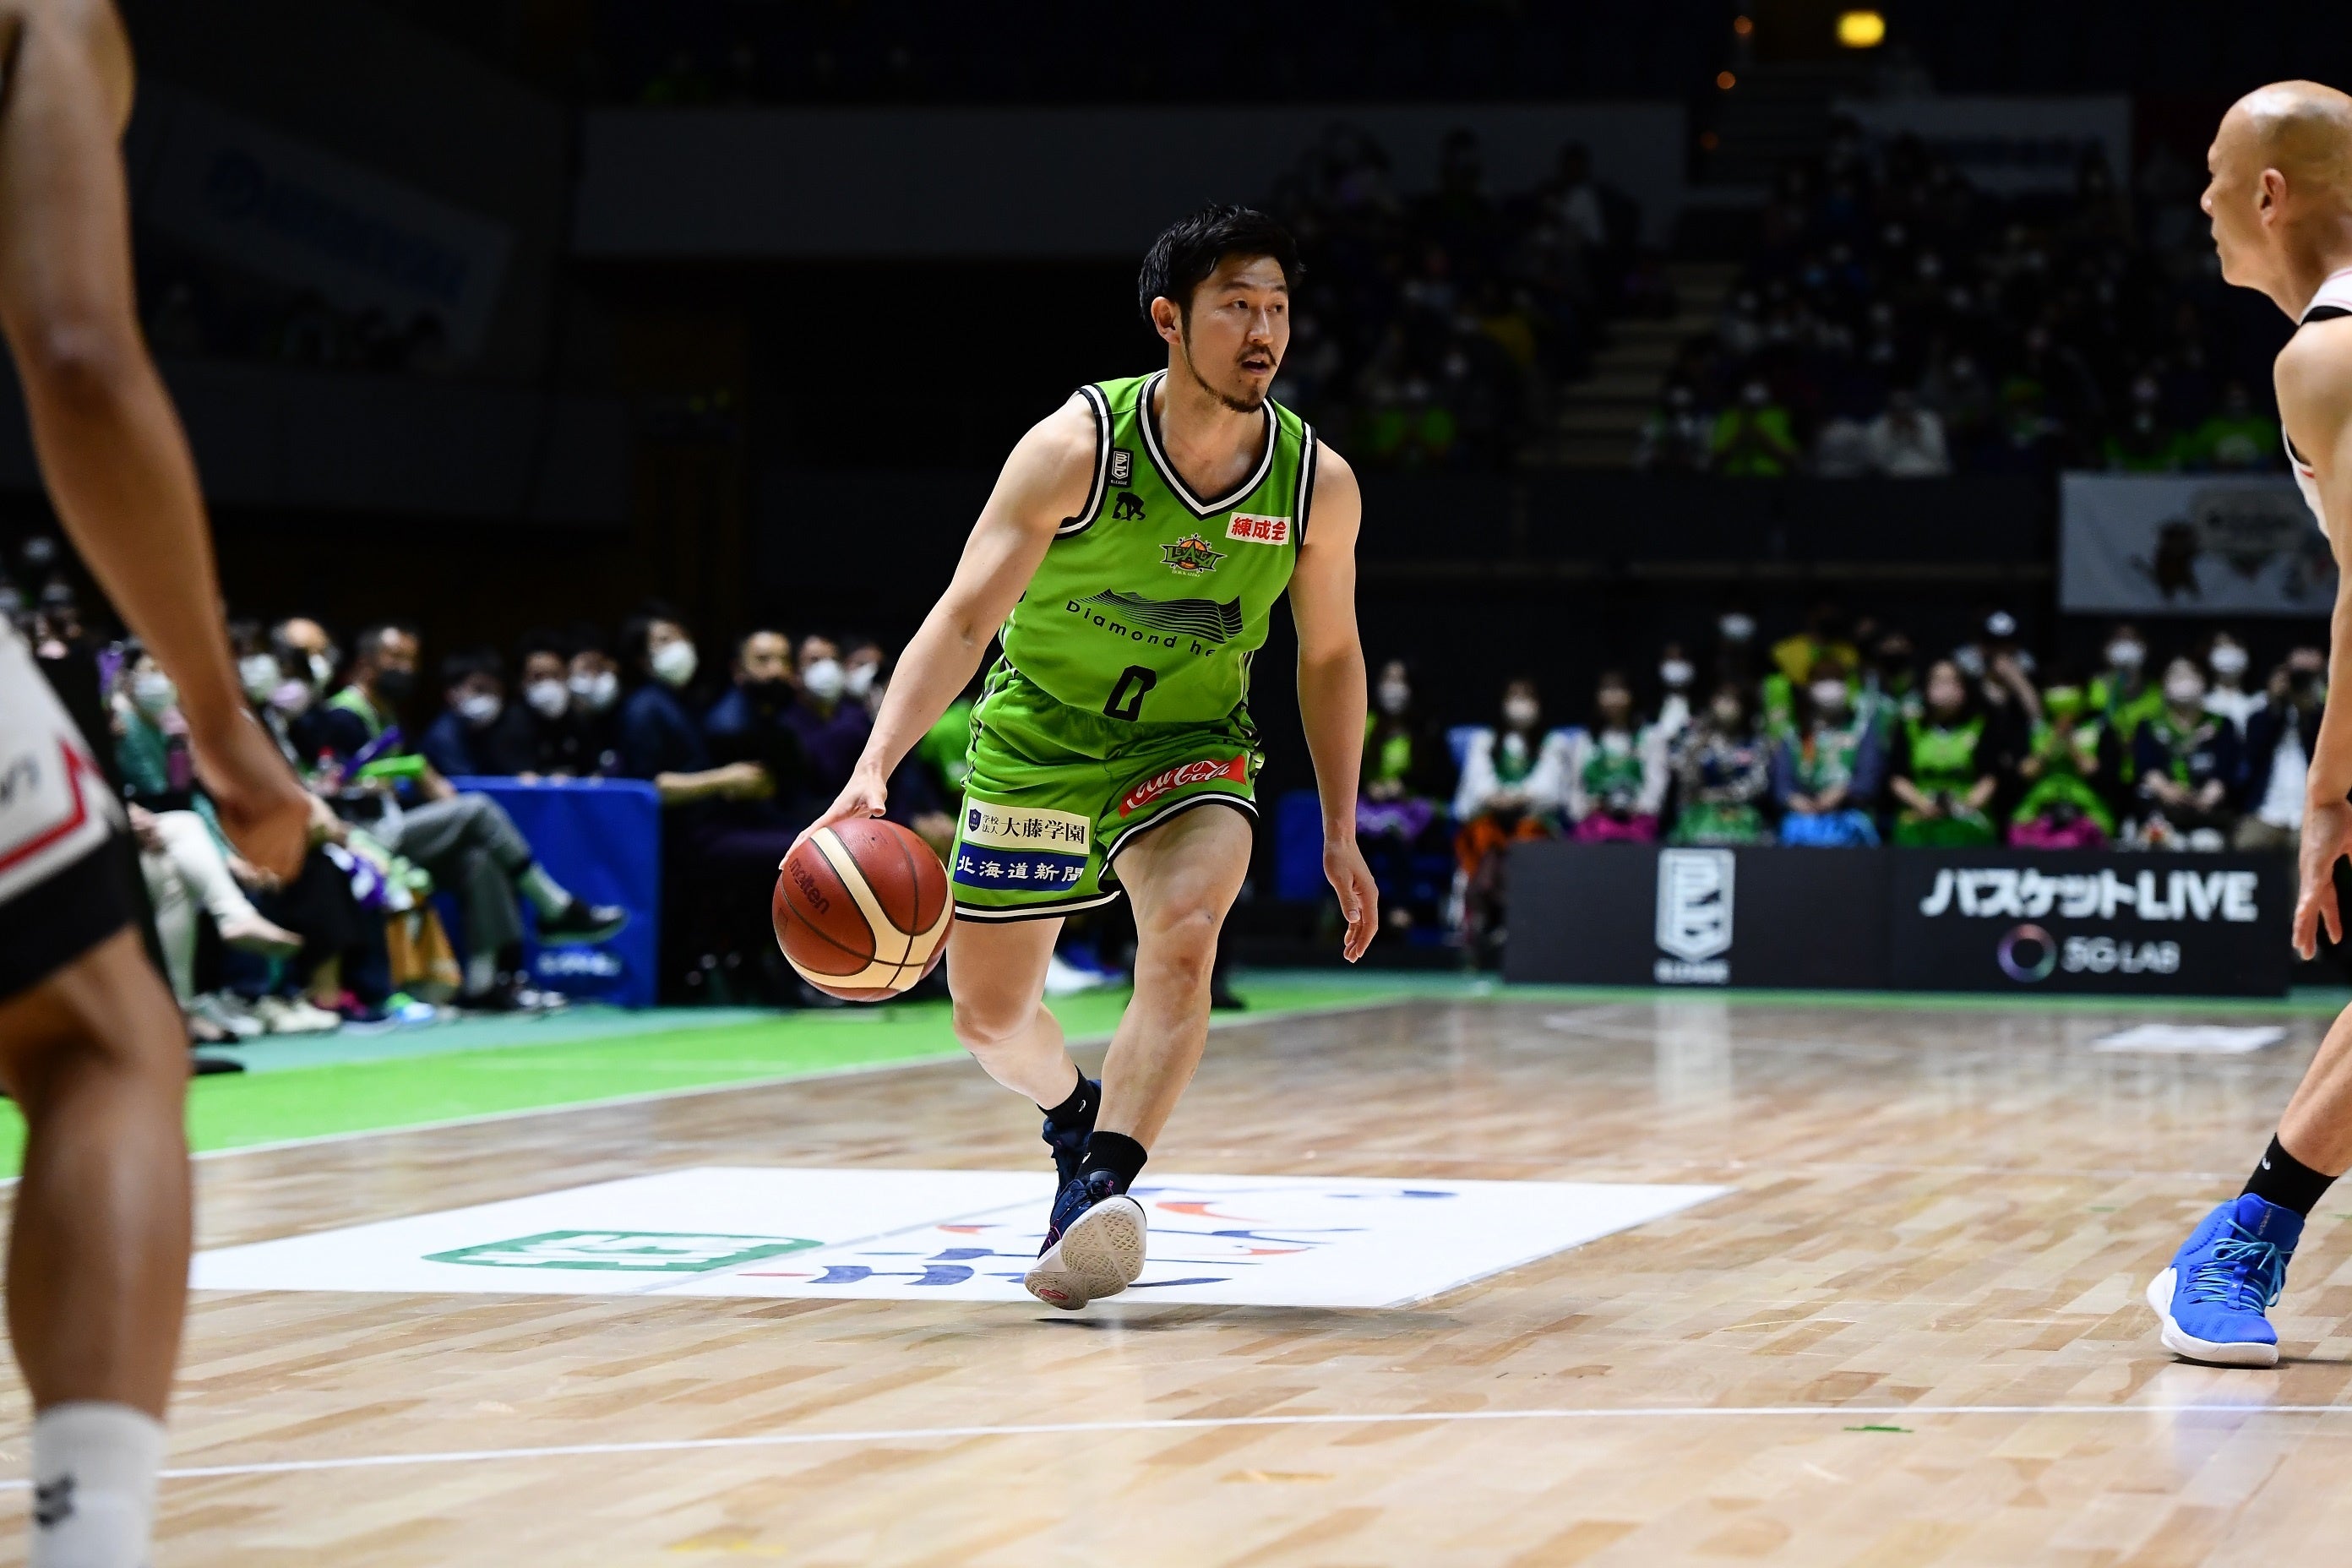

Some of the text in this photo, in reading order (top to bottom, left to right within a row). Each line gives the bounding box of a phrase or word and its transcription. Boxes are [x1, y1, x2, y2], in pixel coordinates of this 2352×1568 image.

[1231, 516, 1287, 542] 練成会
[1065, 600, 1178, 649] Diamond
[1102, 665, 1157, 722] 0
[982, 824, 999, 835] 法人
[983, 814, 999, 825] 学校
[1000, 817, 1086, 844] 大藤学園
[957, 855, 1085, 882] 北海道新聞
[789, 858, 830, 915] molten
